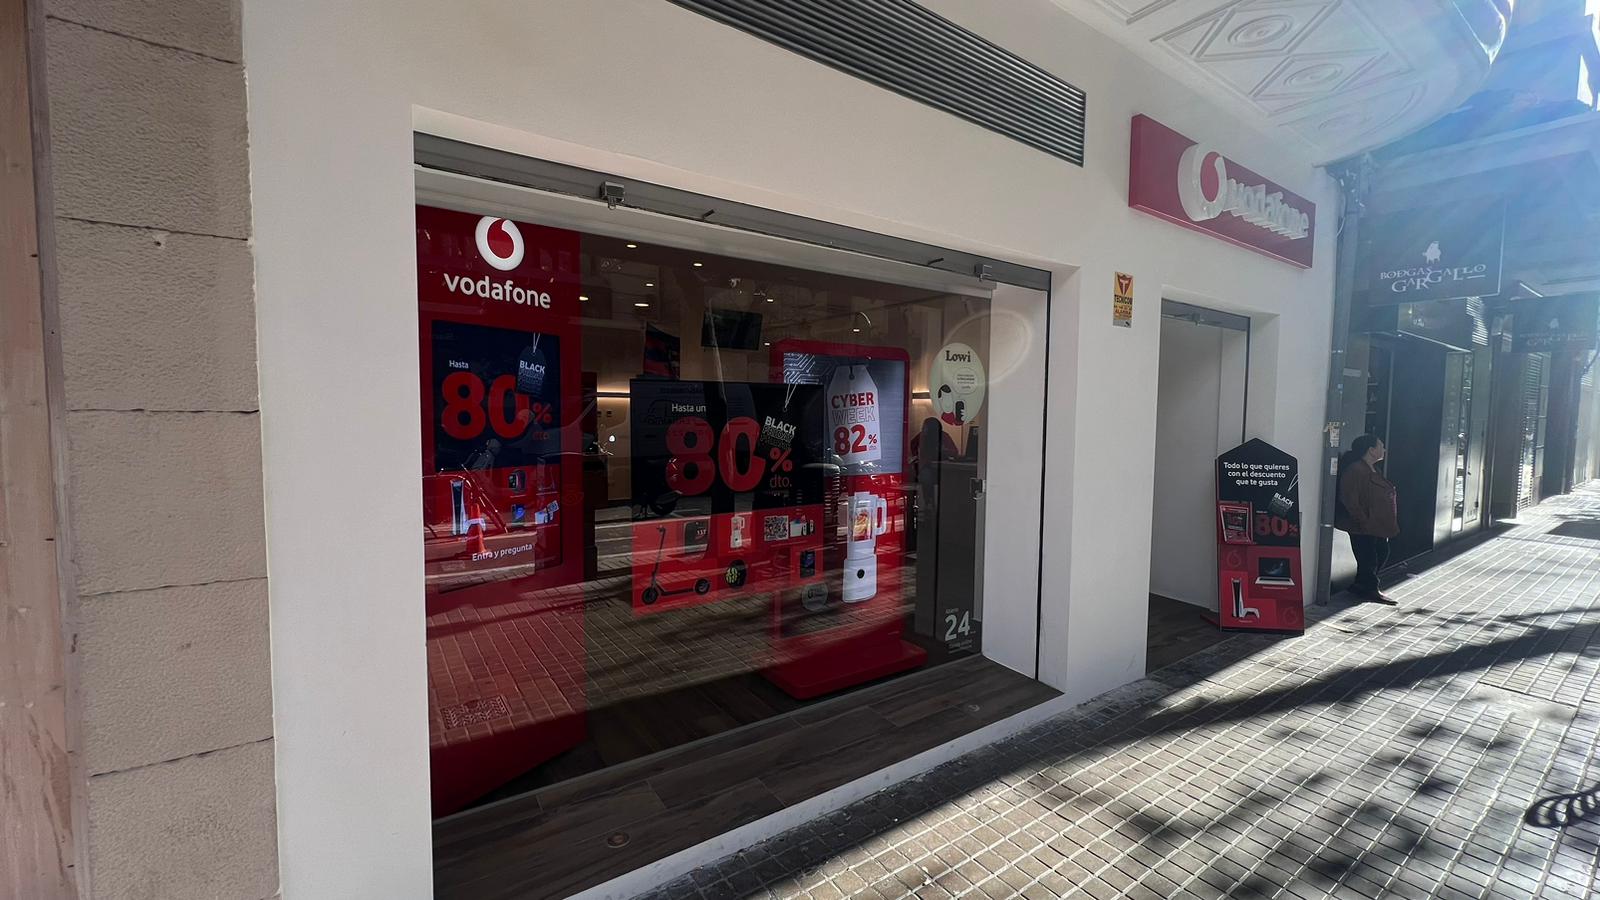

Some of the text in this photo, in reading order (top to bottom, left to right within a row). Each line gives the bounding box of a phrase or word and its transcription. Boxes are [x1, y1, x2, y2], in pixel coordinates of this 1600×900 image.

[443, 273, 551, 309] vodafone
[448, 360, 469, 369] Hasta
[945, 350, 971, 363] Lowi
[519, 360, 546, 374] BLACK
[671, 403, 707, 412] Hasta un
[831, 392, 875, 409] CYBER
[832, 406, 876, 425] WEEK
[764, 415, 797, 436] BLACK
[769, 474, 793, 489] dto.
[1273, 492, 1295, 507] BLACK
[472, 543, 533, 561] Entra y pregunta
[945, 610, 970, 641] 24
